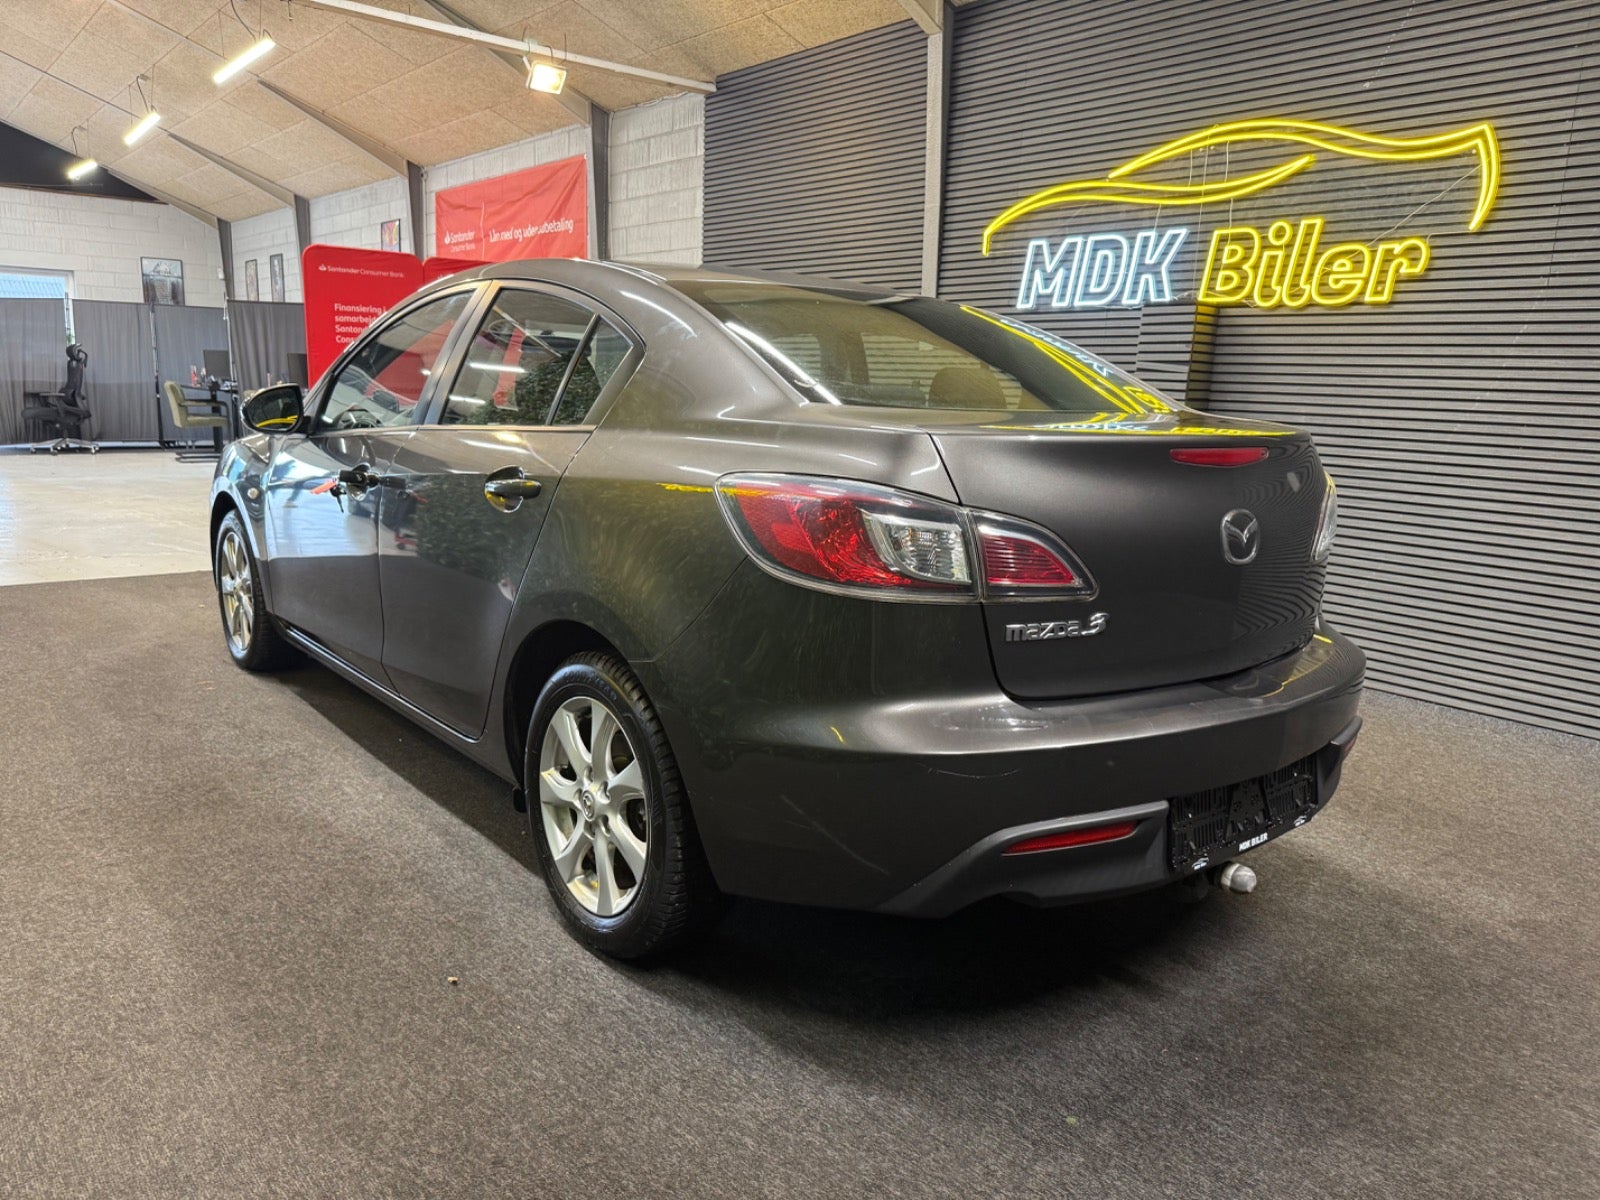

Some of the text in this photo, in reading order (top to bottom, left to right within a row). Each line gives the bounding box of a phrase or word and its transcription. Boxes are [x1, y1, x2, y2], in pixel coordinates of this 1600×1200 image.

[450, 230, 475, 243] Santander
[514, 228, 523, 243] og
[1016, 217, 1431, 310] MDK Biler
[328, 265, 360, 274] Santander
[360, 268, 389, 276] Consumer
[334, 303, 382, 315] Finansiering
